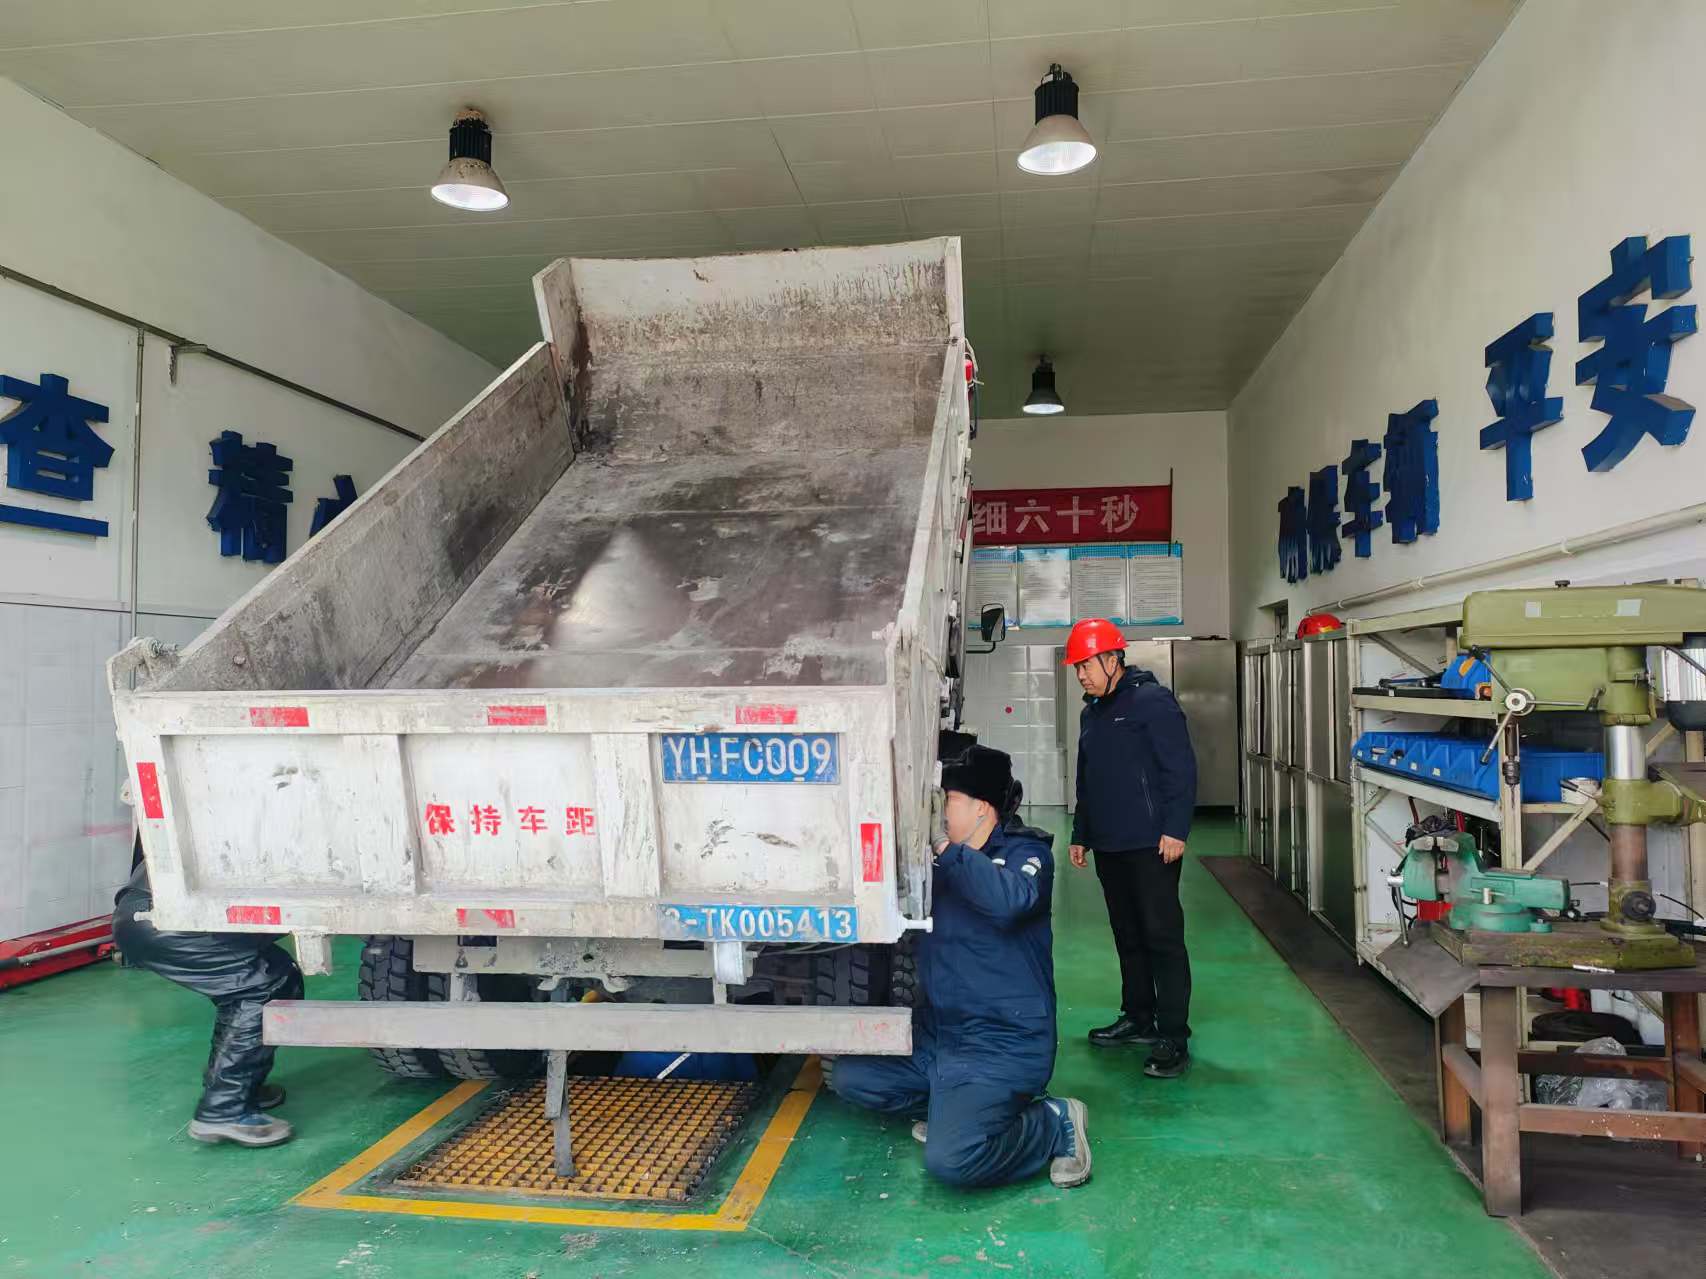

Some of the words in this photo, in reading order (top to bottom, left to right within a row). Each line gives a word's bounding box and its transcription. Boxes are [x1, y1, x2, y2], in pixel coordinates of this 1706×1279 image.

[973, 495, 1139, 535] 细六十秒
[424, 803, 596, 836] 保持车距
